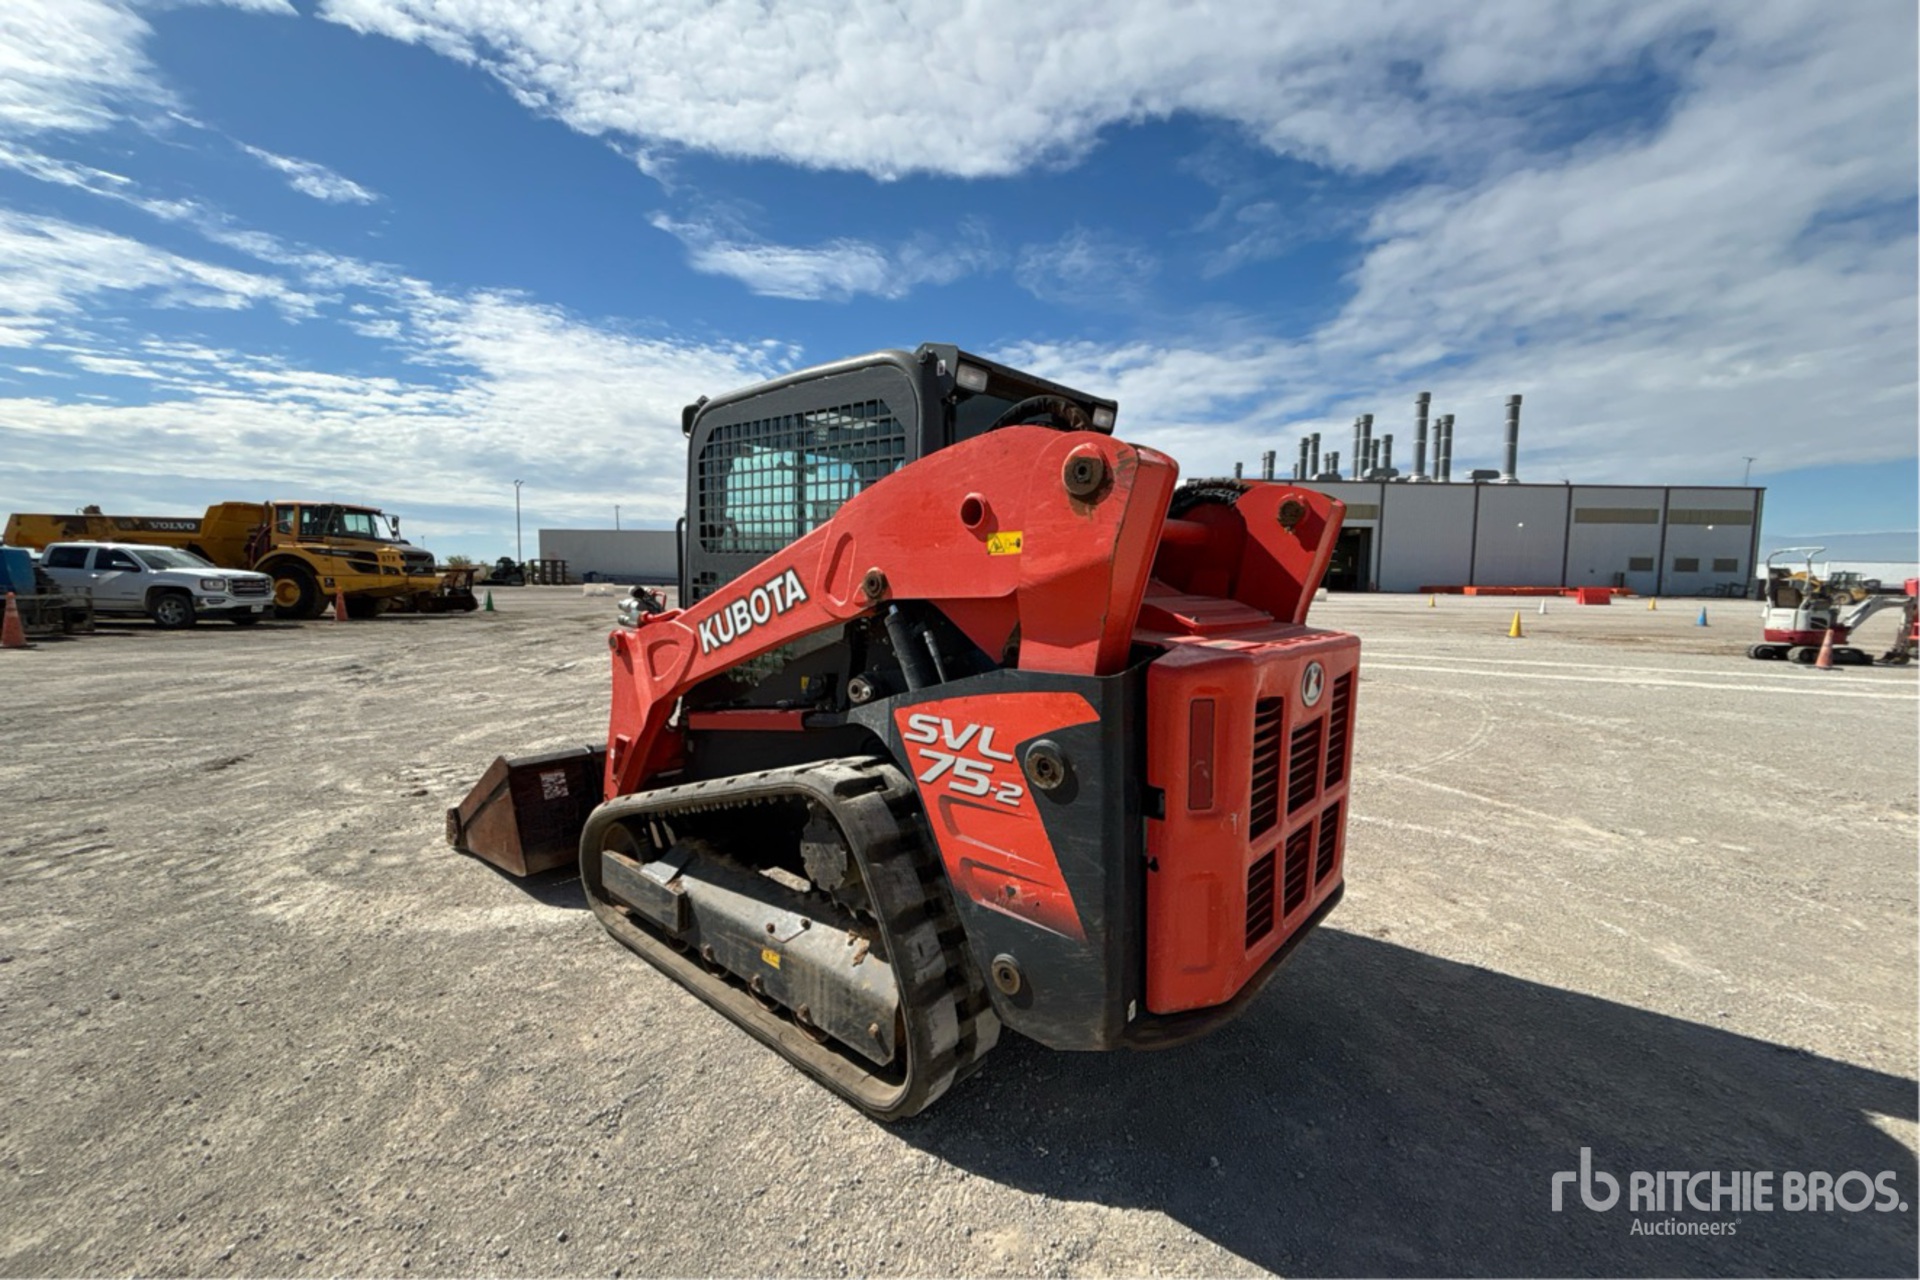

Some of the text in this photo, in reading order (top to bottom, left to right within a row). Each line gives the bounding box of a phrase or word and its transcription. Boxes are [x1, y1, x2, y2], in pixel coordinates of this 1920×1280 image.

[149, 521, 196, 530] VOLVO
[698, 567, 808, 655] KUBOTA
[904, 713, 1014, 762] SVL
[918, 748, 1023, 806] 75-2
